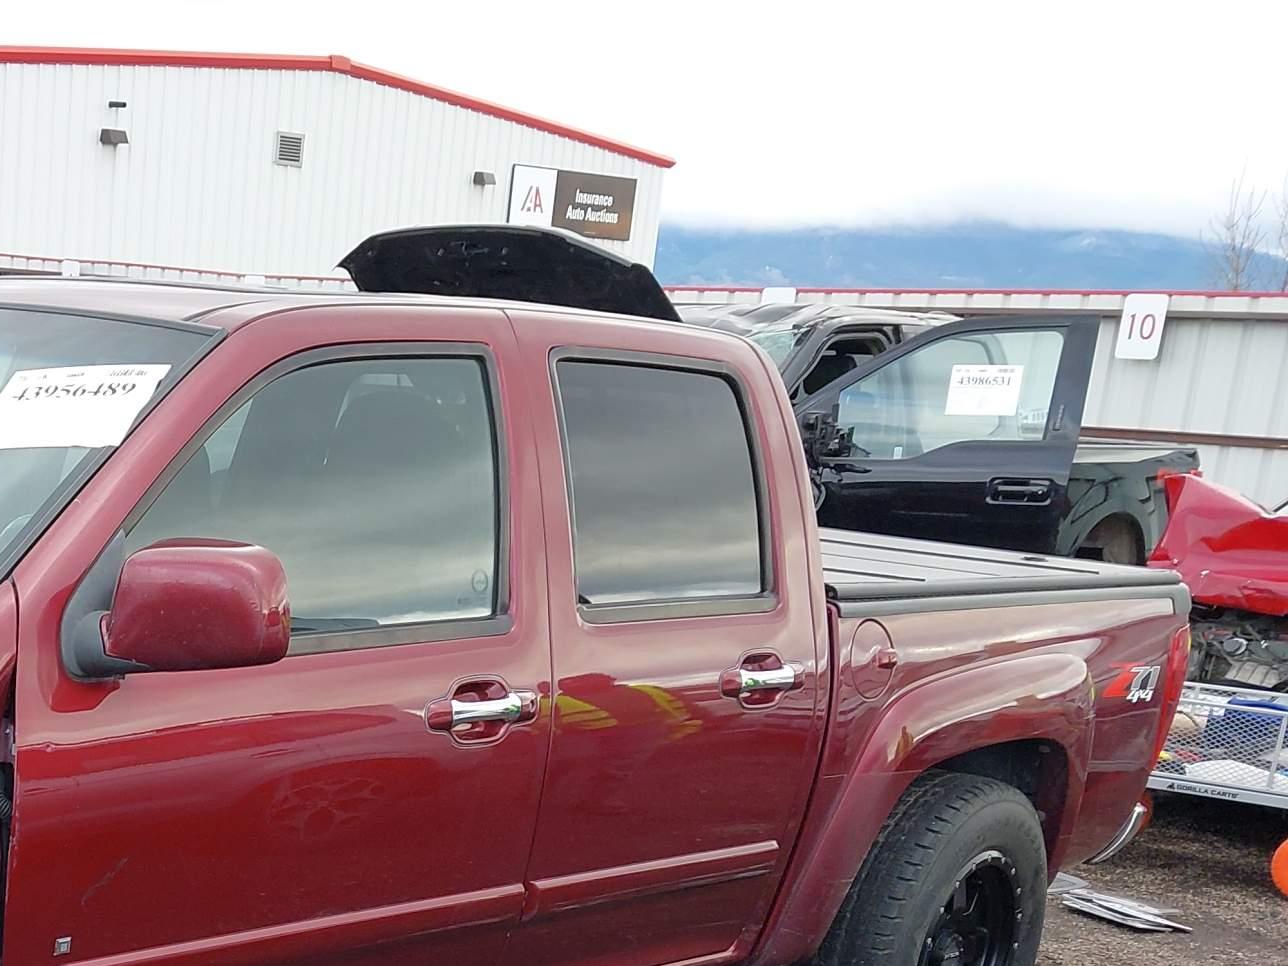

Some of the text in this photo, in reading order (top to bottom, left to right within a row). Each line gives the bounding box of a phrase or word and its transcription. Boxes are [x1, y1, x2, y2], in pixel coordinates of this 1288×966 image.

[575, 188, 613, 206] Insurance
[565, 205, 619, 224] Auto Auctions
[1127, 312, 1156, 341] 10
[956, 375, 1012, 387] 43986531
[12, 382, 138, 402] 43956489
[1102, 662, 1162, 699] Z71
[1175, 784, 1209, 795] GORILLA
